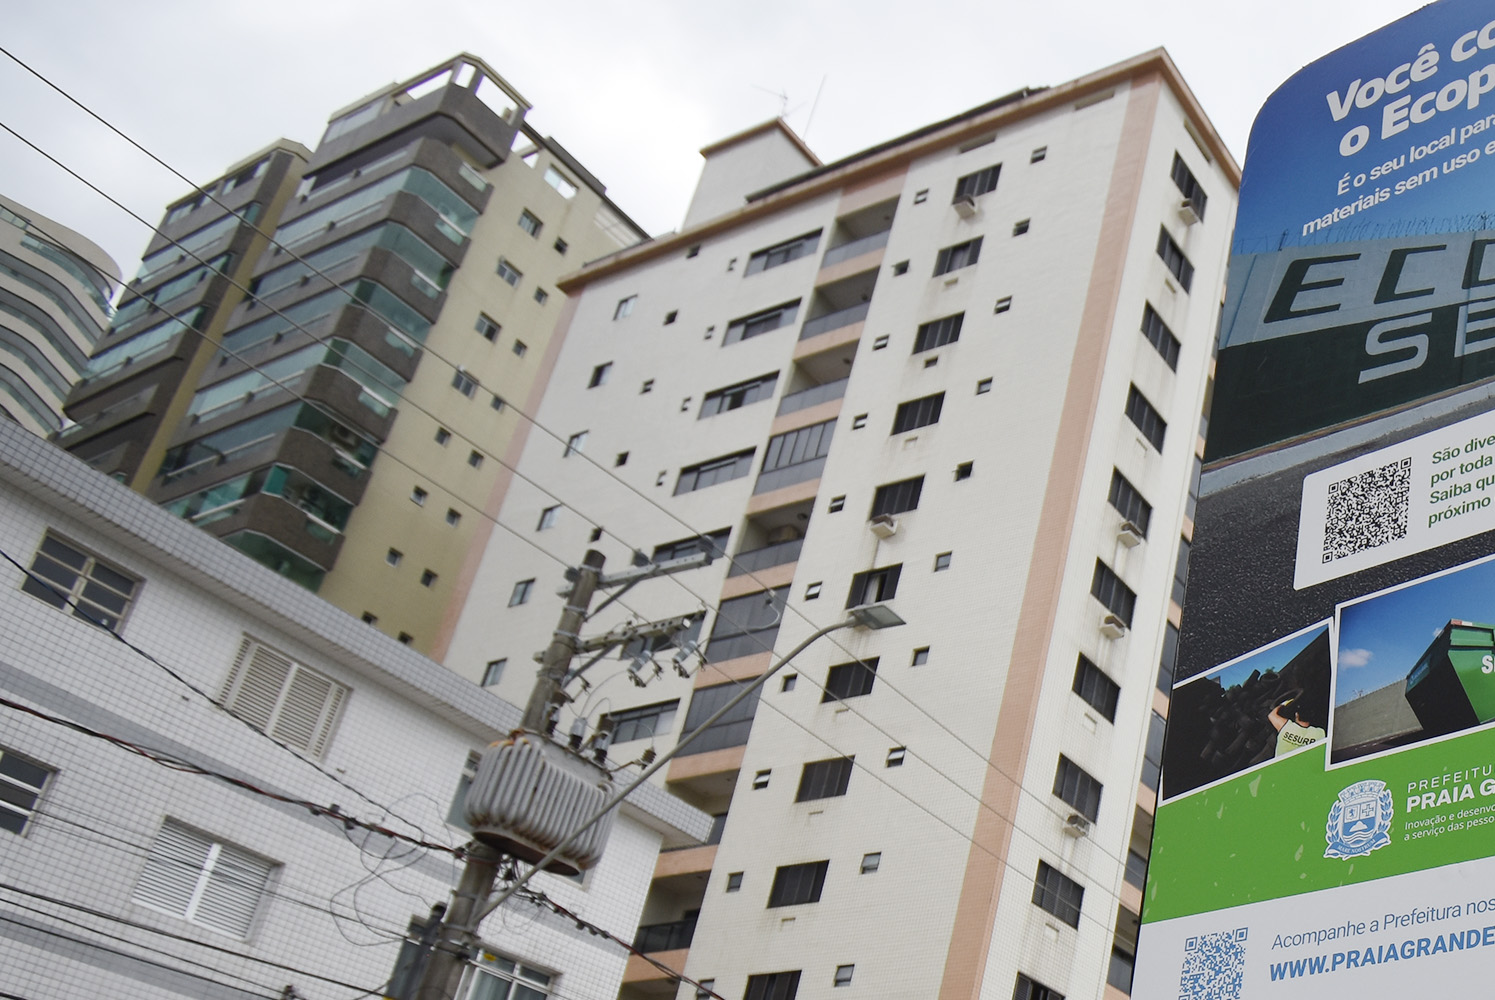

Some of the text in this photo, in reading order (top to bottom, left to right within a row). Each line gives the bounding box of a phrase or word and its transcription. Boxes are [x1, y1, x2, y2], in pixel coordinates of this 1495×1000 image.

[1326, 43, 1440, 122] Você
[1339, 125, 1370, 157] o
[1337, 172, 1351, 195] É
[1353, 173, 1366, 188] o
[1370, 155, 1405, 180] seu
[1409, 127, 1456, 163] local
[1302, 188, 1391, 237] materiais
[1394, 166, 1438, 195] sem
[1442, 149, 1480, 174] uso
[1432, 446, 1460, 464] São
[1430, 467, 1456, 488] por
[1459, 454, 1493, 475] toda
[1429, 482, 1471, 504] Saiba
[1428, 497, 1491, 528] próximo
[1406, 783, 1475, 813] PRAIA
[1403, 833, 1410, 841] a
[1412, 825, 1445, 841] serviço
[1447, 820, 1465, 832] das
[1404, 814, 1447, 831] Inovação
[1449, 812, 1455, 821] e
[1271, 921, 1366, 950] Acompanhe
[1369, 920, 1379, 933] a
[1383, 904, 1461, 930] Prefeitura
